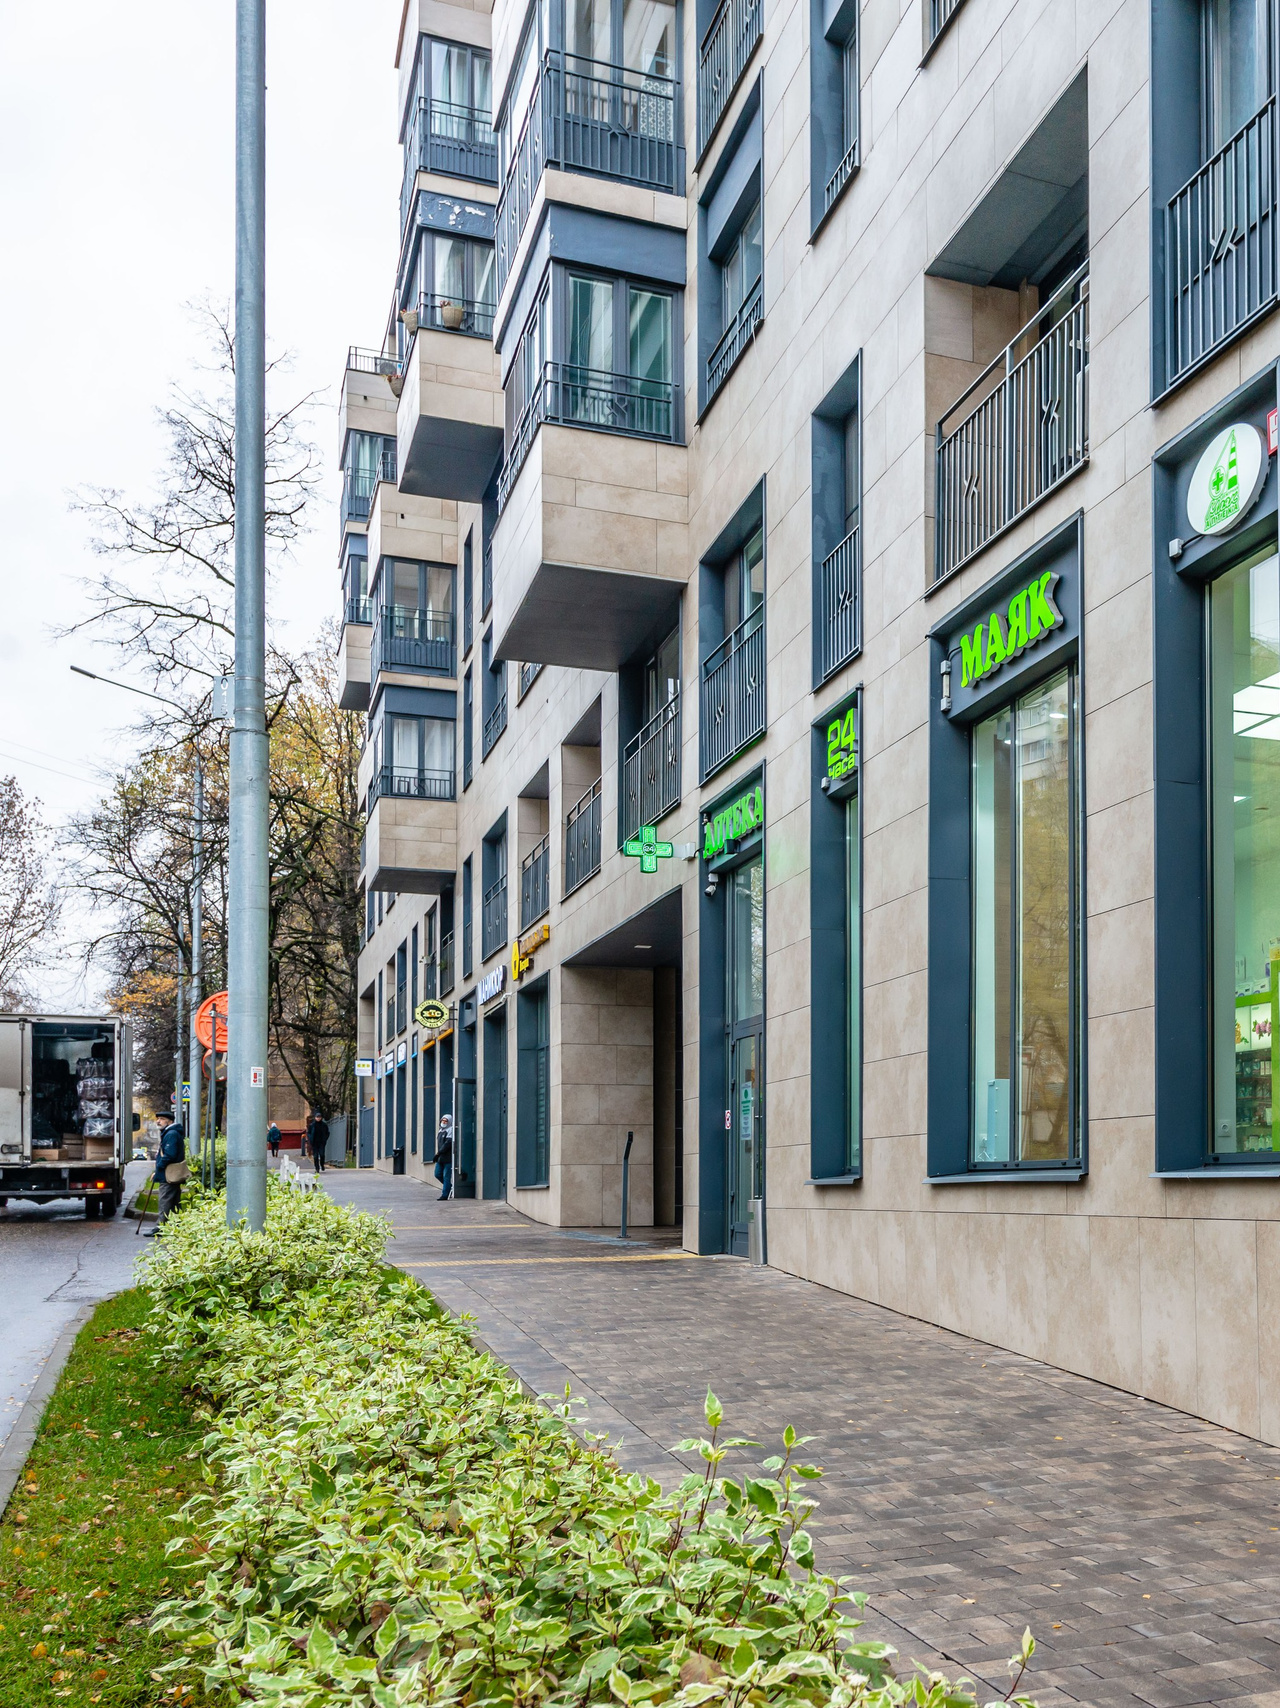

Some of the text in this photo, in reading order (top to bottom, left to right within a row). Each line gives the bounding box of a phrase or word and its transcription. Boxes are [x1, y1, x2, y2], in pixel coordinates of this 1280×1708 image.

[959, 570, 1062, 688] МАЯК
[827, 708, 857, 765] 24
[827, 752, 857, 781] часа
[644, 845, 655, 853] 24
[702, 786, 763, 860] АПТЕКА
